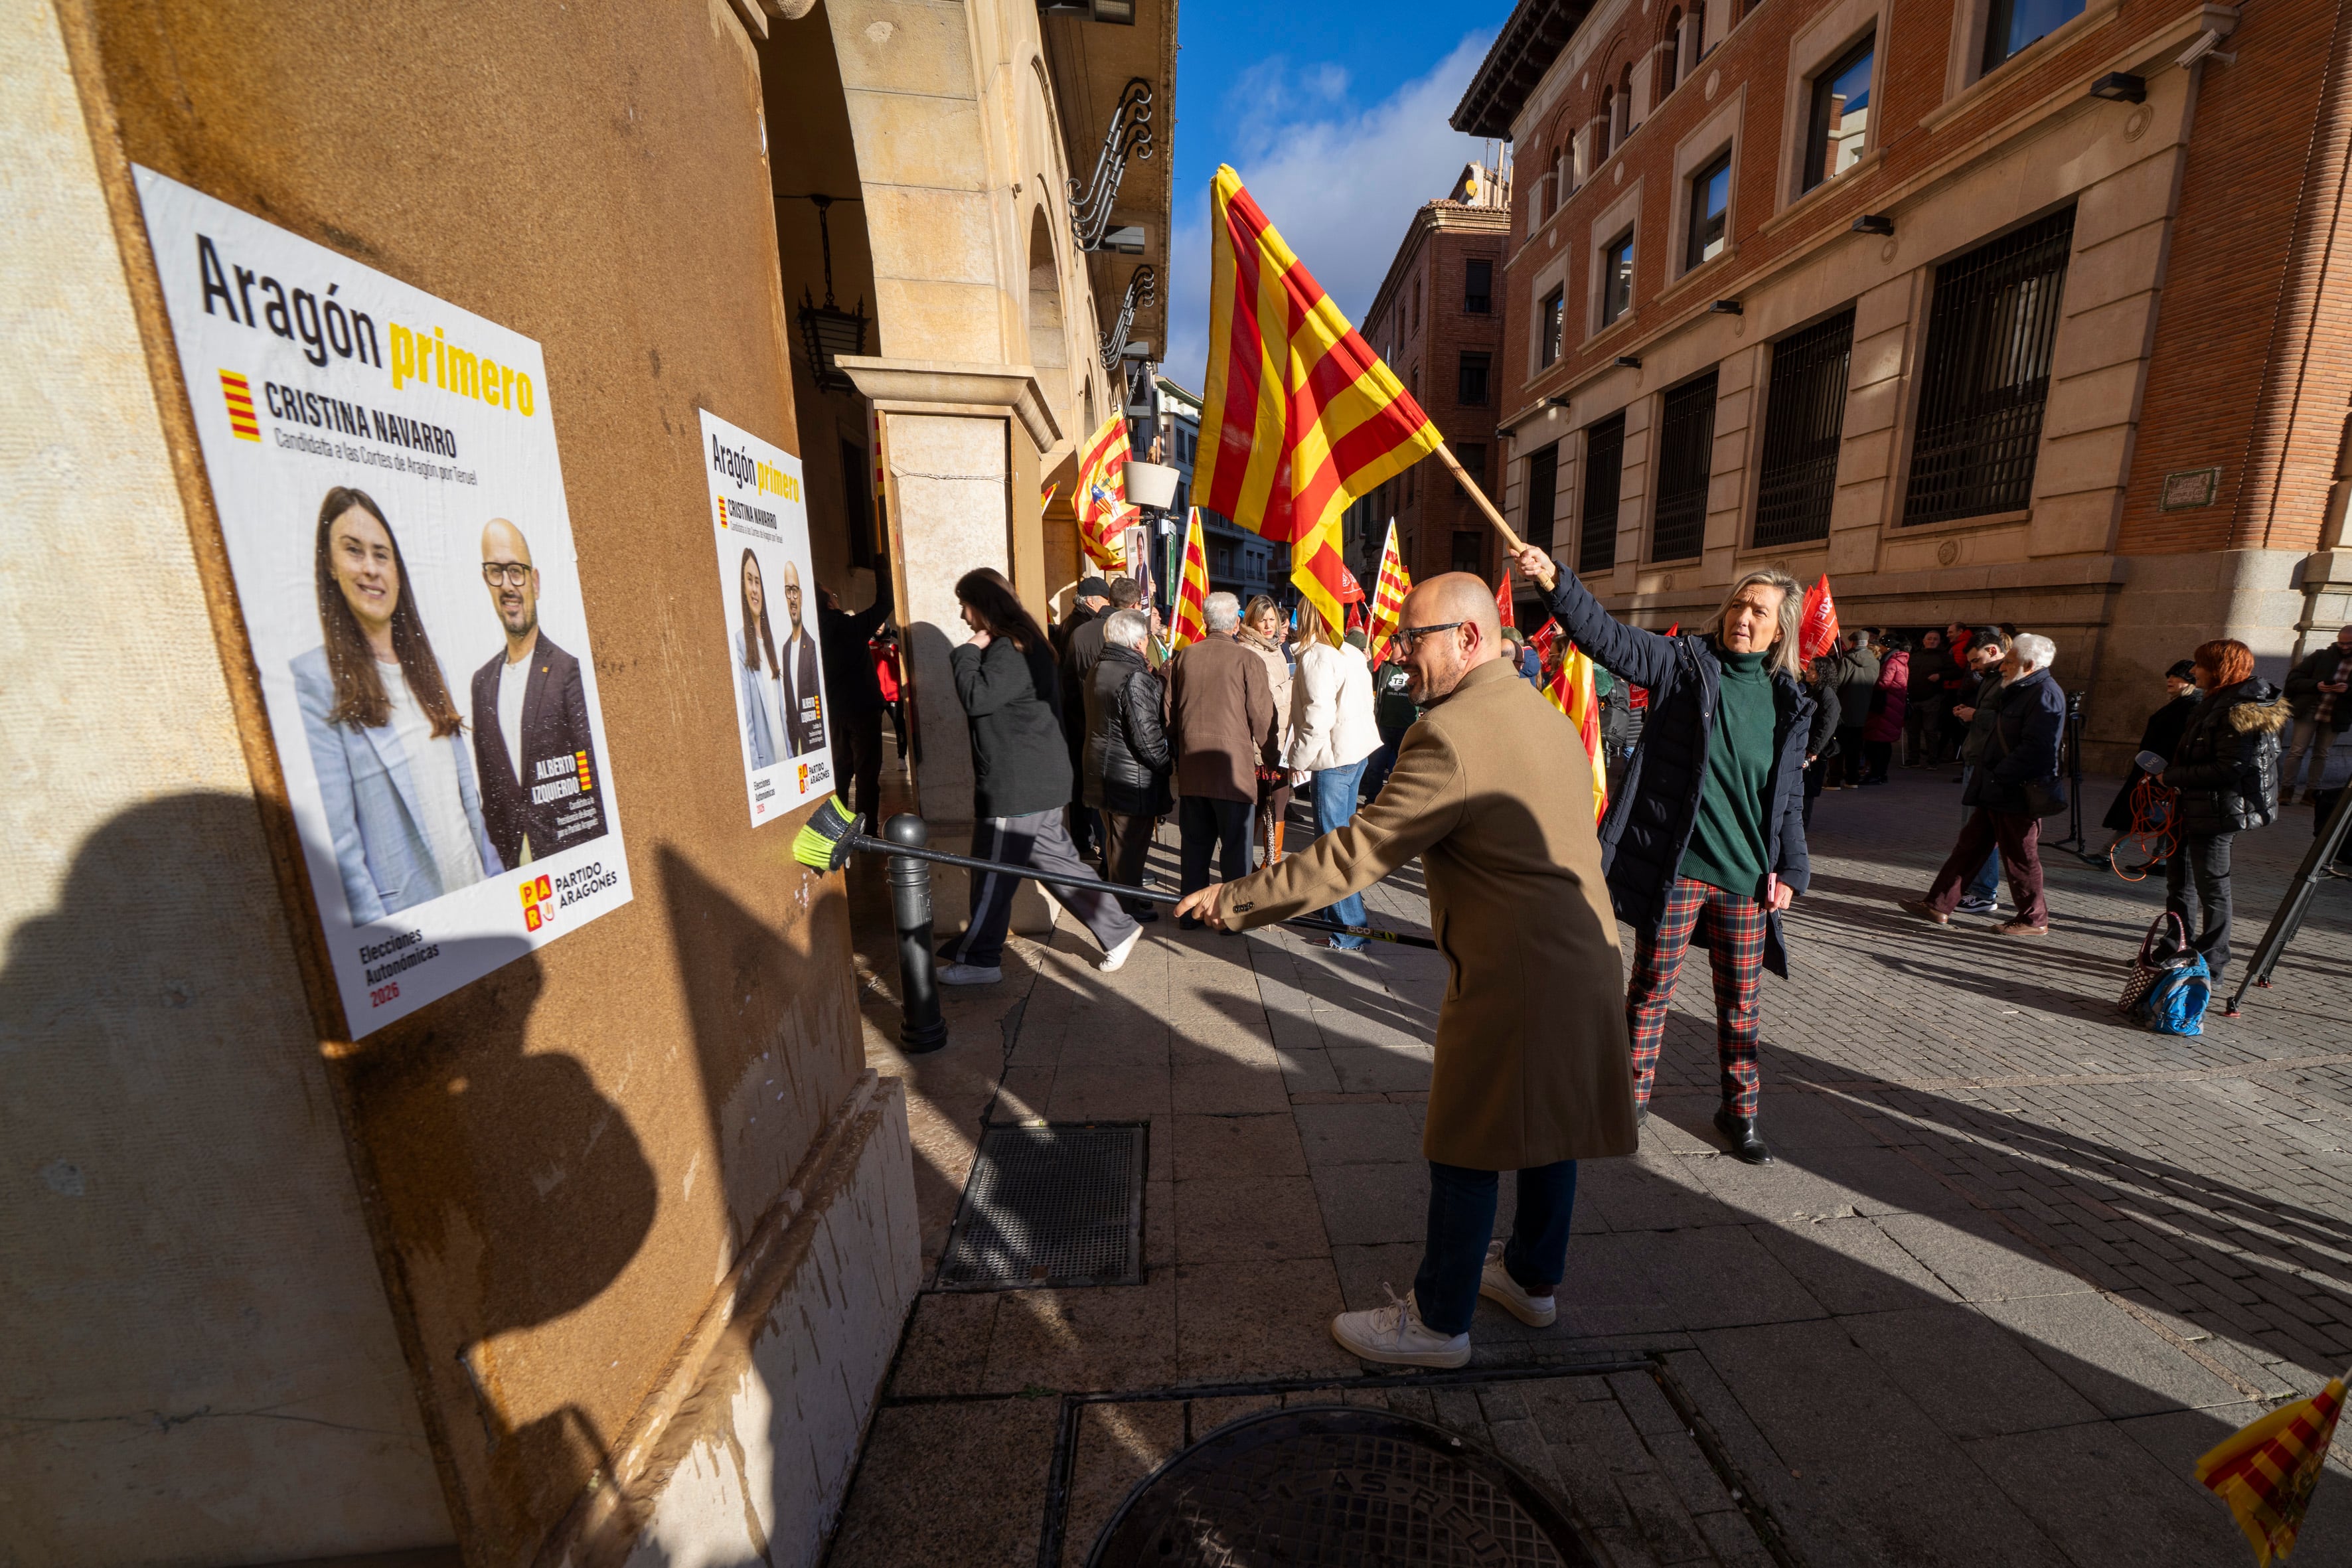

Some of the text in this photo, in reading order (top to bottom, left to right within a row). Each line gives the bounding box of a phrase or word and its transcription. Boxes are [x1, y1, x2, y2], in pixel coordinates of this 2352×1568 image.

[196, 233, 534, 417] Aragón primero
[265, 380, 457, 459] CRISTINA NAVARRO
[274, 428, 478, 486] Candidata a las Cortes de Aragón por Teruel
[712, 433, 799, 503] Aragón primero
[728, 499, 777, 530] CRISTINA NAVARRO
[536, 755, 576, 779] ALBERTO
[809, 762, 824, 775] PARTIDO
[810, 769, 830, 785] ARAGONÉS
[532, 777, 580, 805] IZQUIERDO
[555, 861, 602, 892] PARTIDO
[560, 870, 617, 909] ARAGONÉS
[1349, 926, 1371, 935] eco
[358, 929, 423, 965] Elecciones
[364, 944, 439, 987] Autonómicas
[370, 982, 400, 1008] 2026
